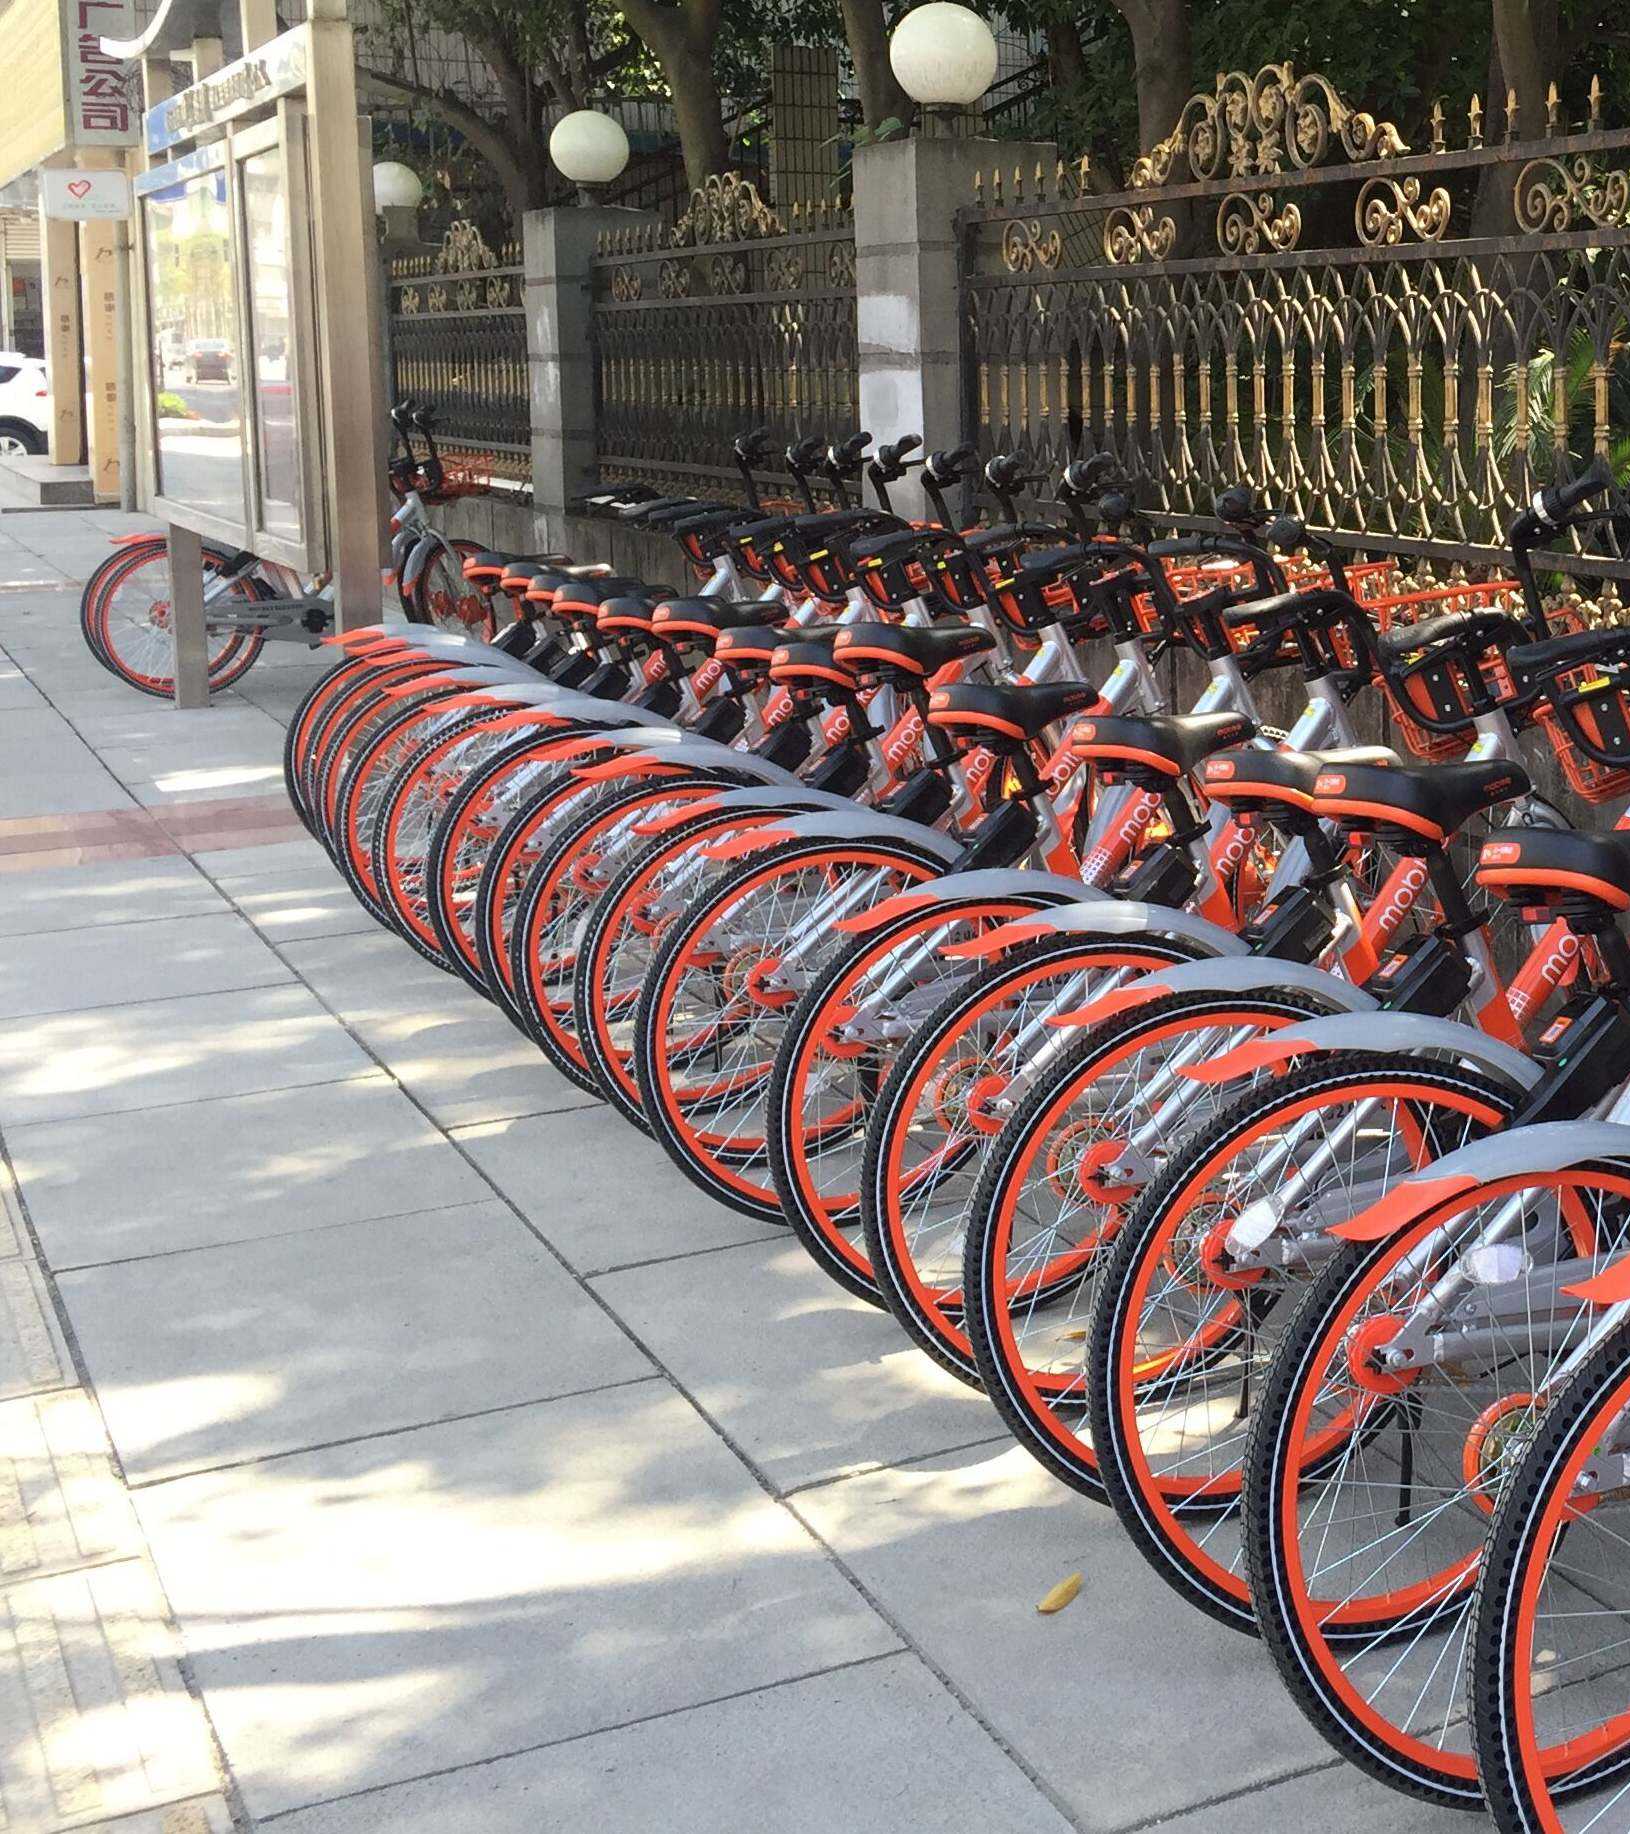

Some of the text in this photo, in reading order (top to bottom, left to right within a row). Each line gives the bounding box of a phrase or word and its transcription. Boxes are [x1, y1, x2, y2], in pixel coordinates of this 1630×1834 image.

[888, 716, 925, 762] mob
[1120, 792, 1161, 845] mob
[1379, 858, 1428, 931] mobi
